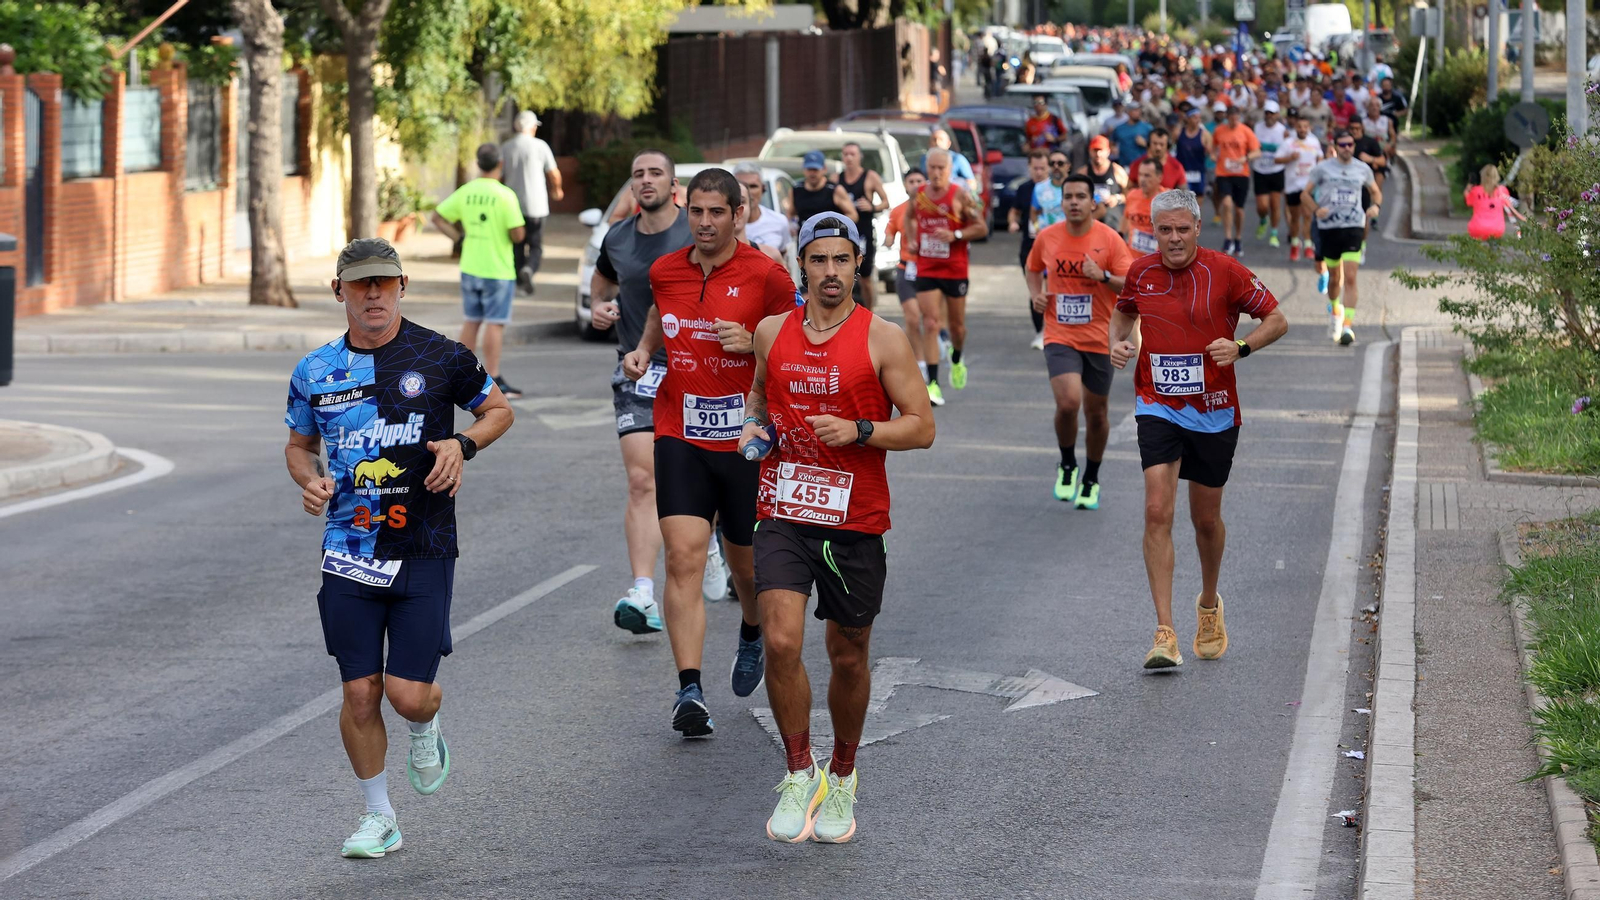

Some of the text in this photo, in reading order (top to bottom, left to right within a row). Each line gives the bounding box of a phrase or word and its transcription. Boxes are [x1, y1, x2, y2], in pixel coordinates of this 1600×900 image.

[1062, 304, 1085, 314] 1037
[721, 358, 749, 368] Down
[791, 363, 827, 374] GENERALI
[1162, 368, 1190, 382] 983
[790, 379, 827, 395] MÁLAGA
[698, 411, 728, 426] 901
[791, 483, 831, 506] 455
